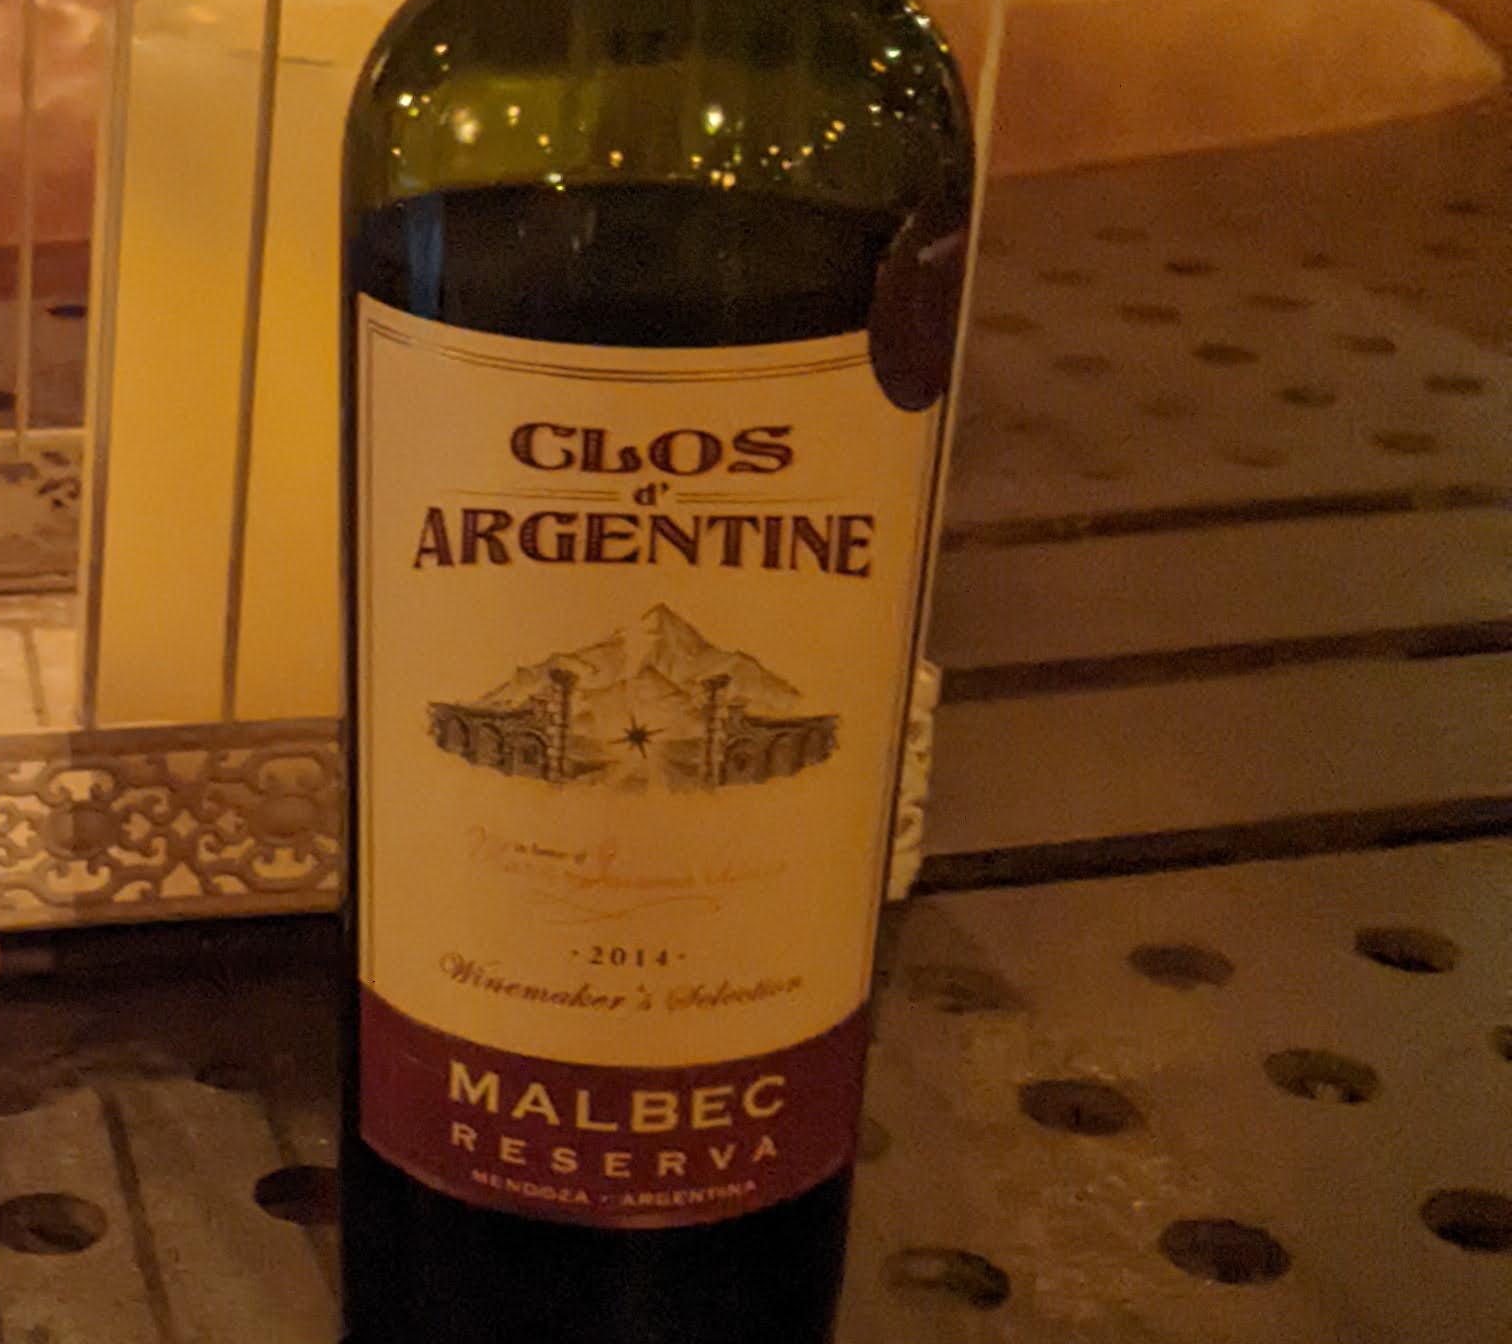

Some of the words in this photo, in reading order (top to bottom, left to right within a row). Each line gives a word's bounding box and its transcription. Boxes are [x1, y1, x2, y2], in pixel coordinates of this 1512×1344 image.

[509, 421, 794, 474] CLOS
[413, 507, 875, 578] ARGENTINE
[448, 1060, 786, 1133] MALBEC
[450, 1121, 778, 1179] RESERVA
[472, 1169, 590, 1205] MENDOZA
[622, 1178, 758, 1208] ARGENTINA
